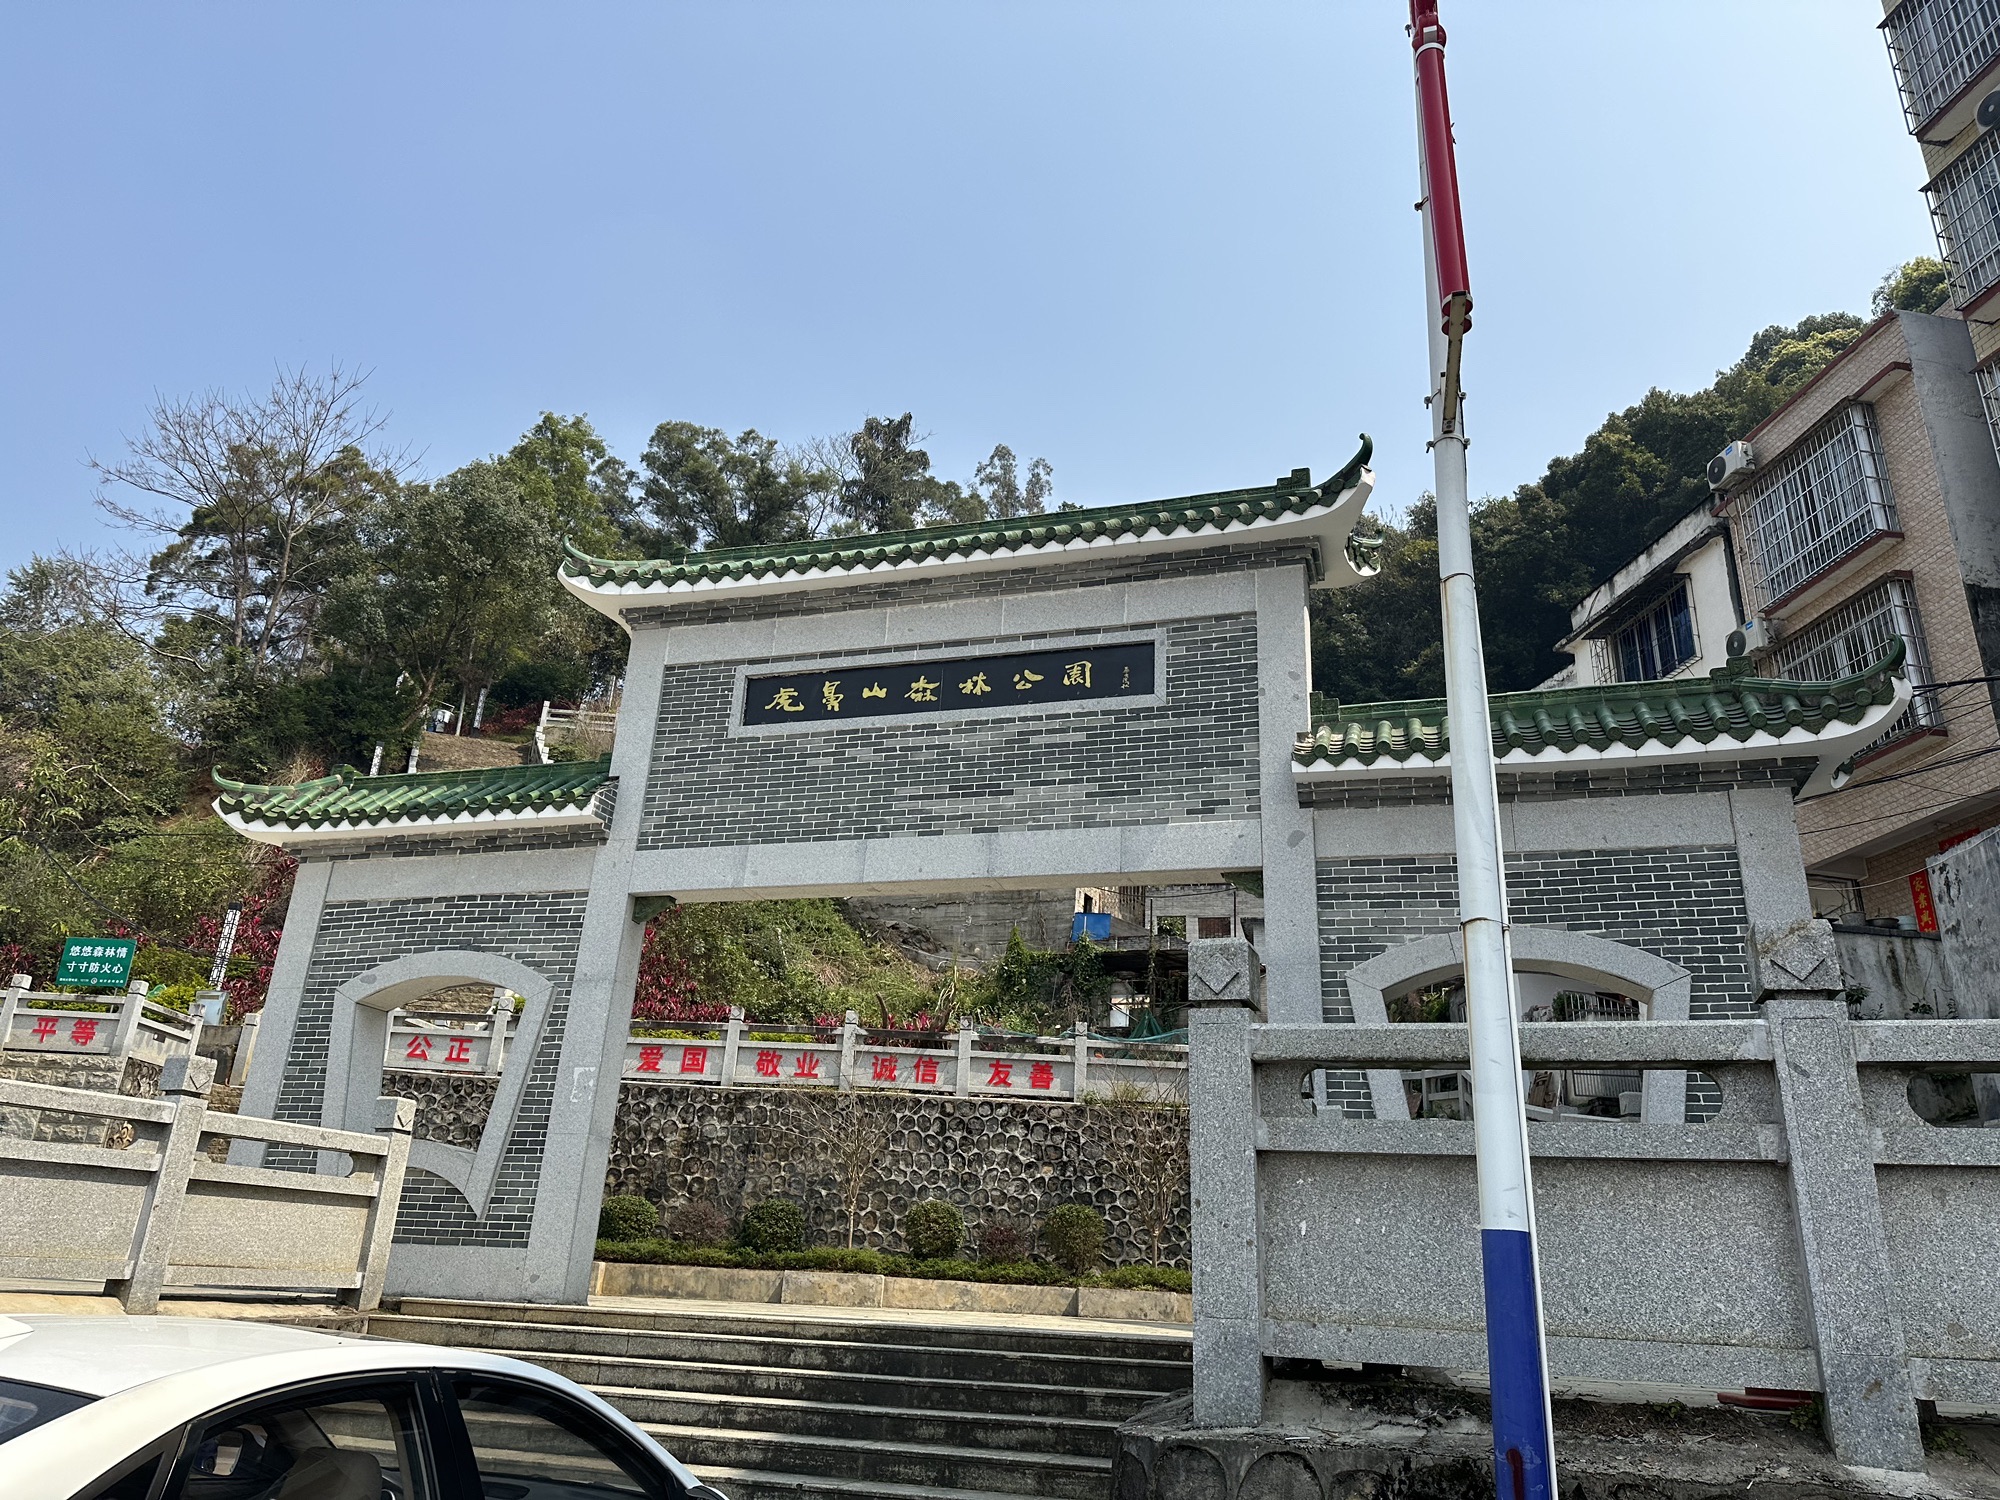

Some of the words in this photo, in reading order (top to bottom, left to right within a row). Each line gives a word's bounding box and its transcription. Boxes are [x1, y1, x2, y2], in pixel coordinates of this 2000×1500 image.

[1913, 876, 1934, 932] 家業興
[69, 945, 128, 958] 悠悠森林情
[66, 961, 123, 973] 寸寸防火心
[32, 1017, 99, 1046] 平等
[407, 1036, 473, 1062] 公正
[637, 1046, 708, 1073] 爱国
[756, 1050, 819, 1079] 敬业
[871, 1055, 939, 1084] 诚信
[988, 1060, 1054, 1089] 友善
